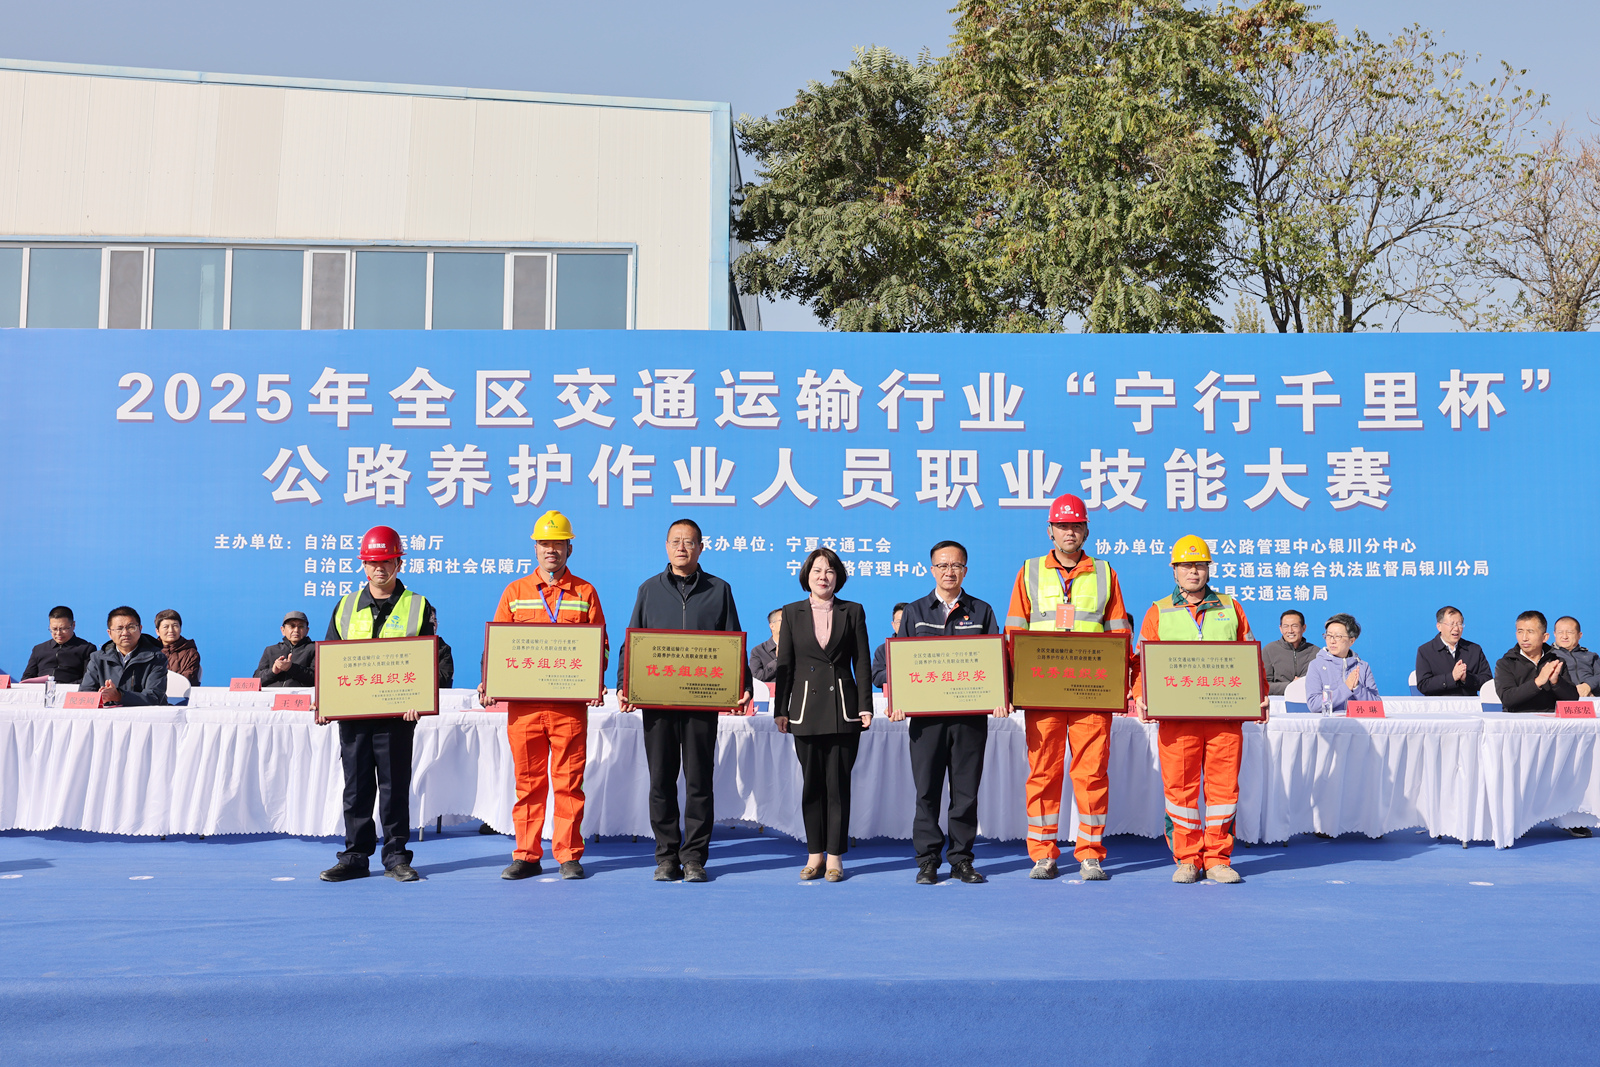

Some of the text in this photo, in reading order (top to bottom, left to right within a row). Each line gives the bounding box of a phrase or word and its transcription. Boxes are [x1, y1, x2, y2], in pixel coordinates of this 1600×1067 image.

[116, 366, 1550, 433] 2025年全区交通运输行业“宁行千里杯”
[262, 443, 1393, 511] 公路养护作业人员职业技能大赛
[213, 533, 444, 551] 主办单位：自治区输厅
[1095, 537, 1417, 555] 协办单位：夏公路管理中心银川分中心
[304, 557, 532, 575] 自治区源和社会保障厅
[786, 559, 929, 578] 宁路管理中心
[1208, 559, 1490, 579] 夏交通运输综合执法监督局银川分局
[1209, 585, 1329, 604] 县交通运输局
[505, 657, 583, 670] 优秀组织奖
[645, 664, 724, 679] 优秀组织奖
[337, 671, 417, 687] 优秀组织奖
[908, 669, 987, 684] 优秀组织奖
[1030, 666, 1109, 680] 优秀组织奖
[1163, 675, 1242, 688] 优秀组织奖
